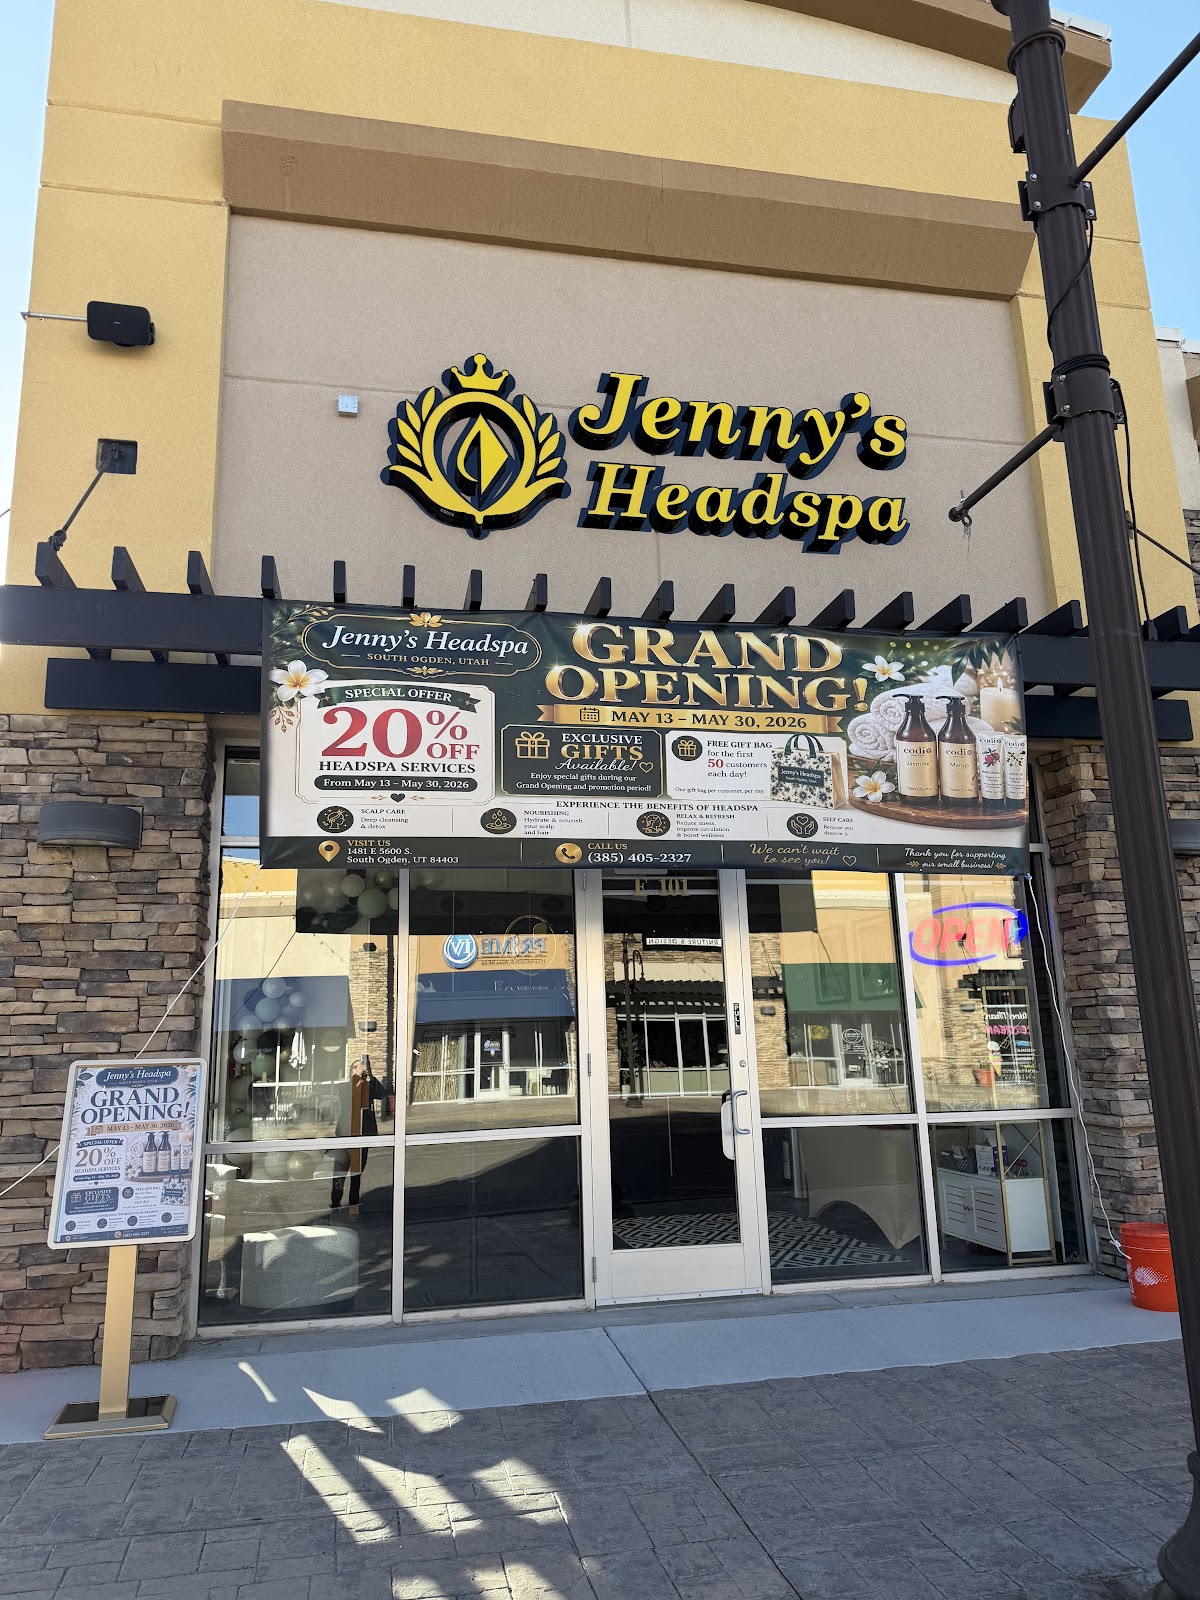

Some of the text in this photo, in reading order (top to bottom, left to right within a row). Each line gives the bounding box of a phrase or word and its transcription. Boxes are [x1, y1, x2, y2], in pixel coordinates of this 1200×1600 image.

[576, 371, 908, 468] Jenny's
[583, 461, 909, 543] Headspa
[321, 624, 529, 658] Jenny's Headspa
[571, 622, 843, 673] GRAND
[366, 652, 490, 667] SOUTH OGDEN, UTAH
[544, 664, 869, 712] OPENING!
[344, 687, 452, 703] SPECIAL OFFER
[611, 710, 651, 723] MAY
[655, 712, 674, 724] 13
[690, 713, 728, 726] MAY
[734, 715, 761, 729] 30,
[764, 716, 808, 729] 2026
[321, 706, 469, 759] 20%
[561, 732, 643, 745] EXCLUSIVE
[706, 739, 773, 749] FREE GIFT BAG
[425, 742, 480, 761] OFF
[560, 743, 644, 761] GIFTS
[721, 750, 735, 758] the
[736, 750, 754, 758] first
[318, 760, 476, 774] HEADSPA SERVICES
[554, 757, 637, 772] Available!
[707, 758, 768, 769] 50 customers
[530, 772, 552, 781] Enjoy
[553, 773, 579, 782] special
[580, 773, 597, 782] gifts
[598, 774, 623, 782] during
[707, 770, 748, 779] each day!
[323, 778, 353, 788] From
[354, 779, 377, 789] May
[379, 779, 391, 788] 13
[401, 779, 424, 790] May
[425, 780, 442, 790] 30,
[443, 780, 470, 790] 2026
[540, 782, 572, 791] Opening
[588, 784, 625, 792] promotion
[556, 801, 620, 809] EXPERIENCE
[622, 802, 644, 810] THE
[646, 802, 694, 811] BENEFITS
[712, 804, 759, 812] HEADSPA
[347, 839, 376, 847] VISIT
[587, 842, 613, 850] CALL
[749, 843, 840, 856] We can't wait
[347, 847, 368, 855] 1481
[404, 848, 413, 856] S.
[587, 852, 693, 864] (385) 405-2327
[904, 847, 932, 858] Thank
[950, 848, 964, 860] for
[965, 851, 1006, 860] supporting
[346, 856, 459, 865] South Ogden, UT 84403
[763, 854, 831, 867] to see you!
[936, 860, 960, 868] small
[960, 860, 994, 869] business!
[658, 878, 690, 896] 101
[914, 916, 1013, 954] OPEN
[104, 1071, 134, 1082] Jenny's
[136, 1069, 172, 1080] Headspa
[90, 1087, 180, 1108] GRAND
[80, 1101, 190, 1125] OPENING!
[75, 1147, 116, 1168] 20%
[104, 1158, 122, 1166] OFF
[84, 1194, 111, 1202] GIFTS
